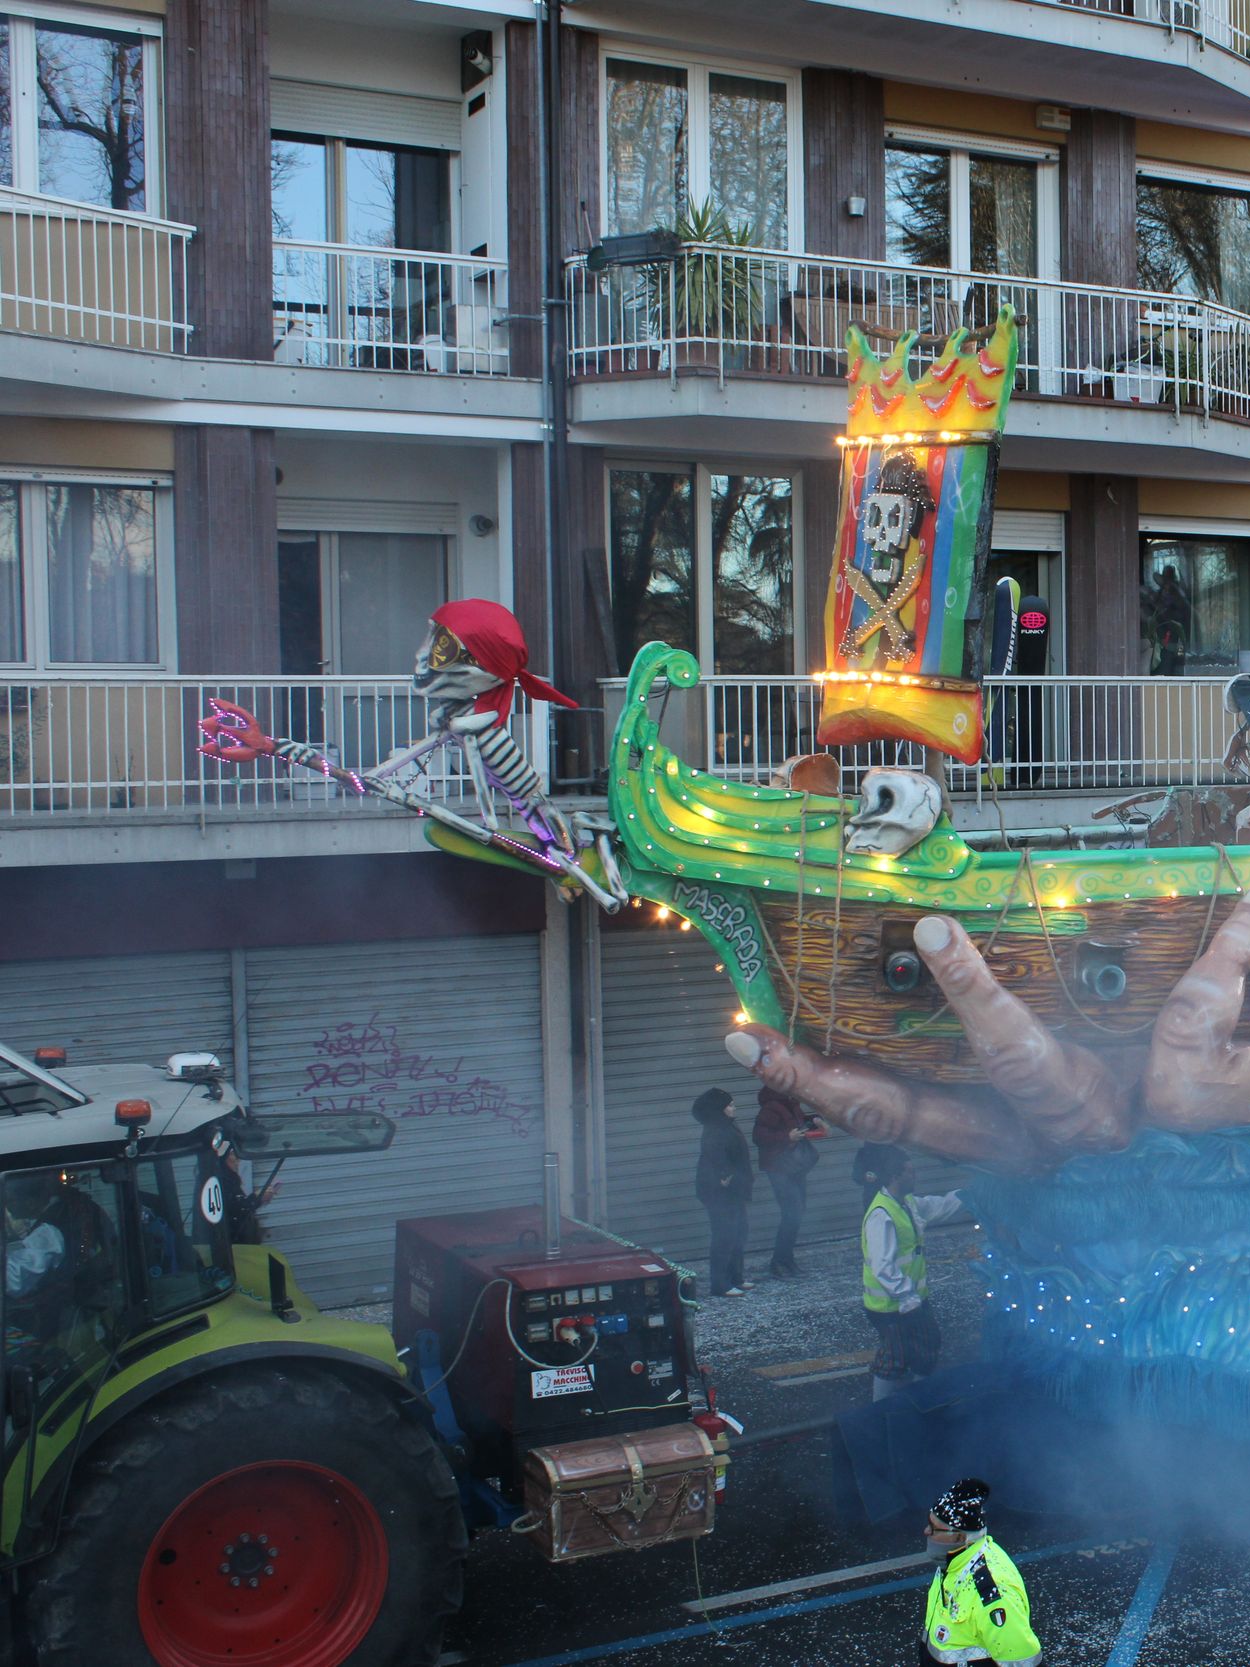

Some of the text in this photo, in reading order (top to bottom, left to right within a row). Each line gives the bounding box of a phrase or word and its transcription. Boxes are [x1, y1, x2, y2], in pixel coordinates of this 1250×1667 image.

[673, 881, 762, 983] MASERADA
[208, 1183, 222, 1216] 40
[555, 1367, 588, 1377] TREVISO
